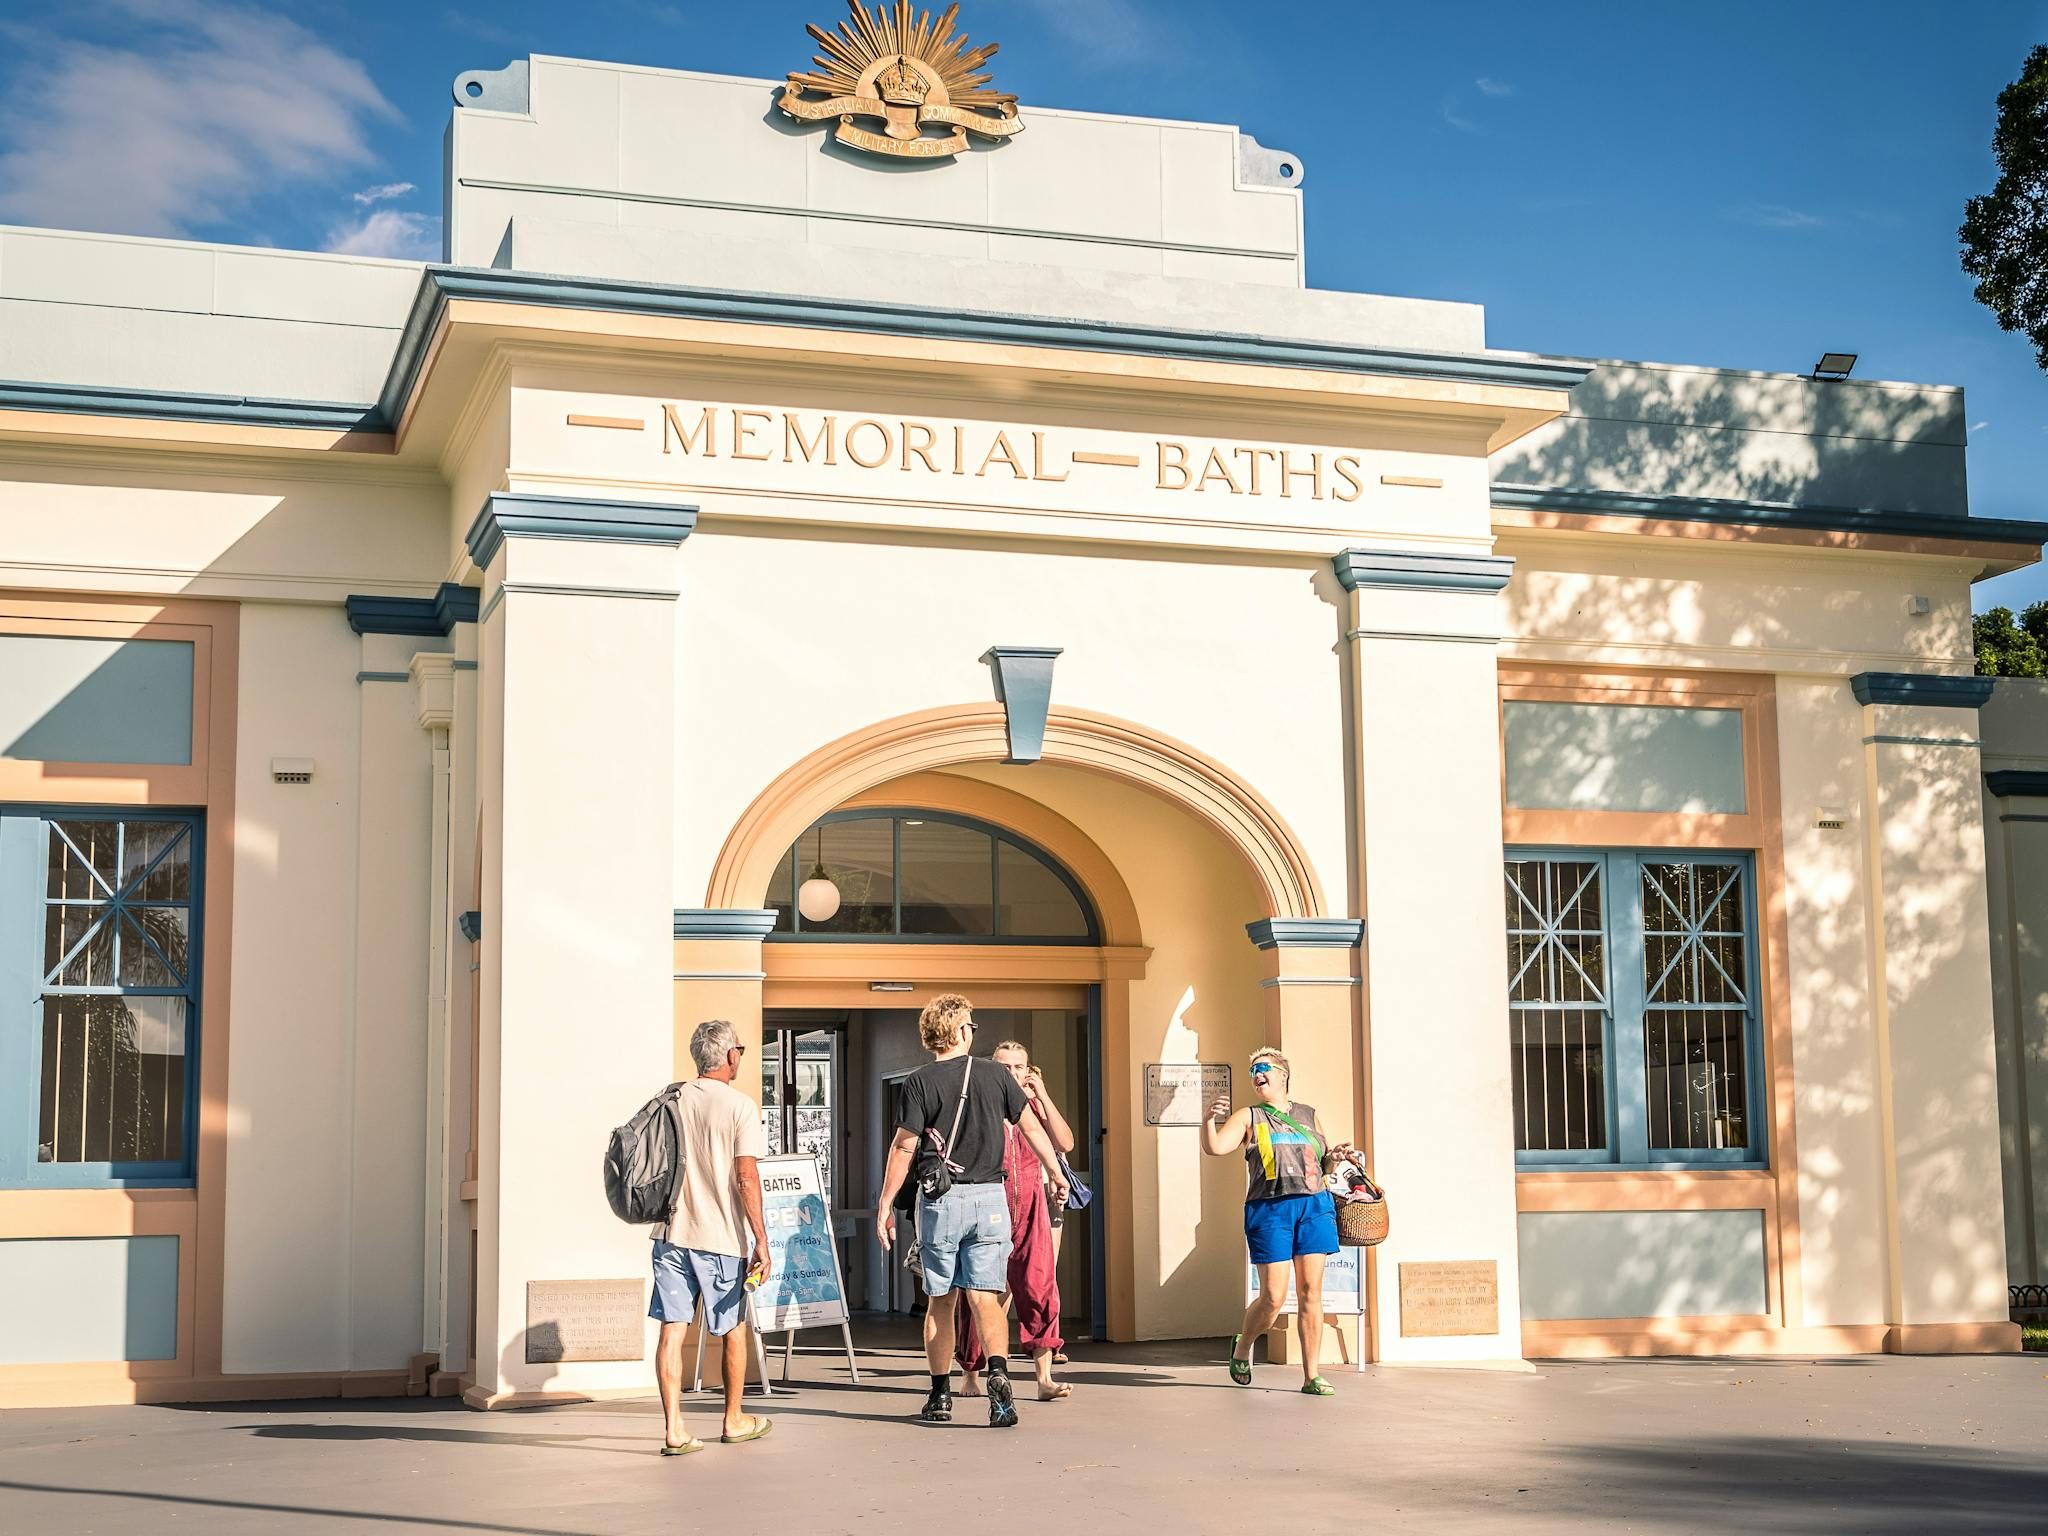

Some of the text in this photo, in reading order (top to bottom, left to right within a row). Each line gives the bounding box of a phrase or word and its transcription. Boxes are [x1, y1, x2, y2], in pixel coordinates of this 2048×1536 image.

[851, 129, 957, 154] MILITARY FORCES
[661, 403, 1364, 502] MEMORIAL BATHS
[1201, 1080, 1230, 1088] COUNCIL
[763, 1177, 802, 1192] BATHS
[764, 1205, 812, 1228] PEN
[794, 1236, 822, 1246] Friday
[792, 1270, 799, 1279] &
[800, 1267, 831, 1278] Sunday
